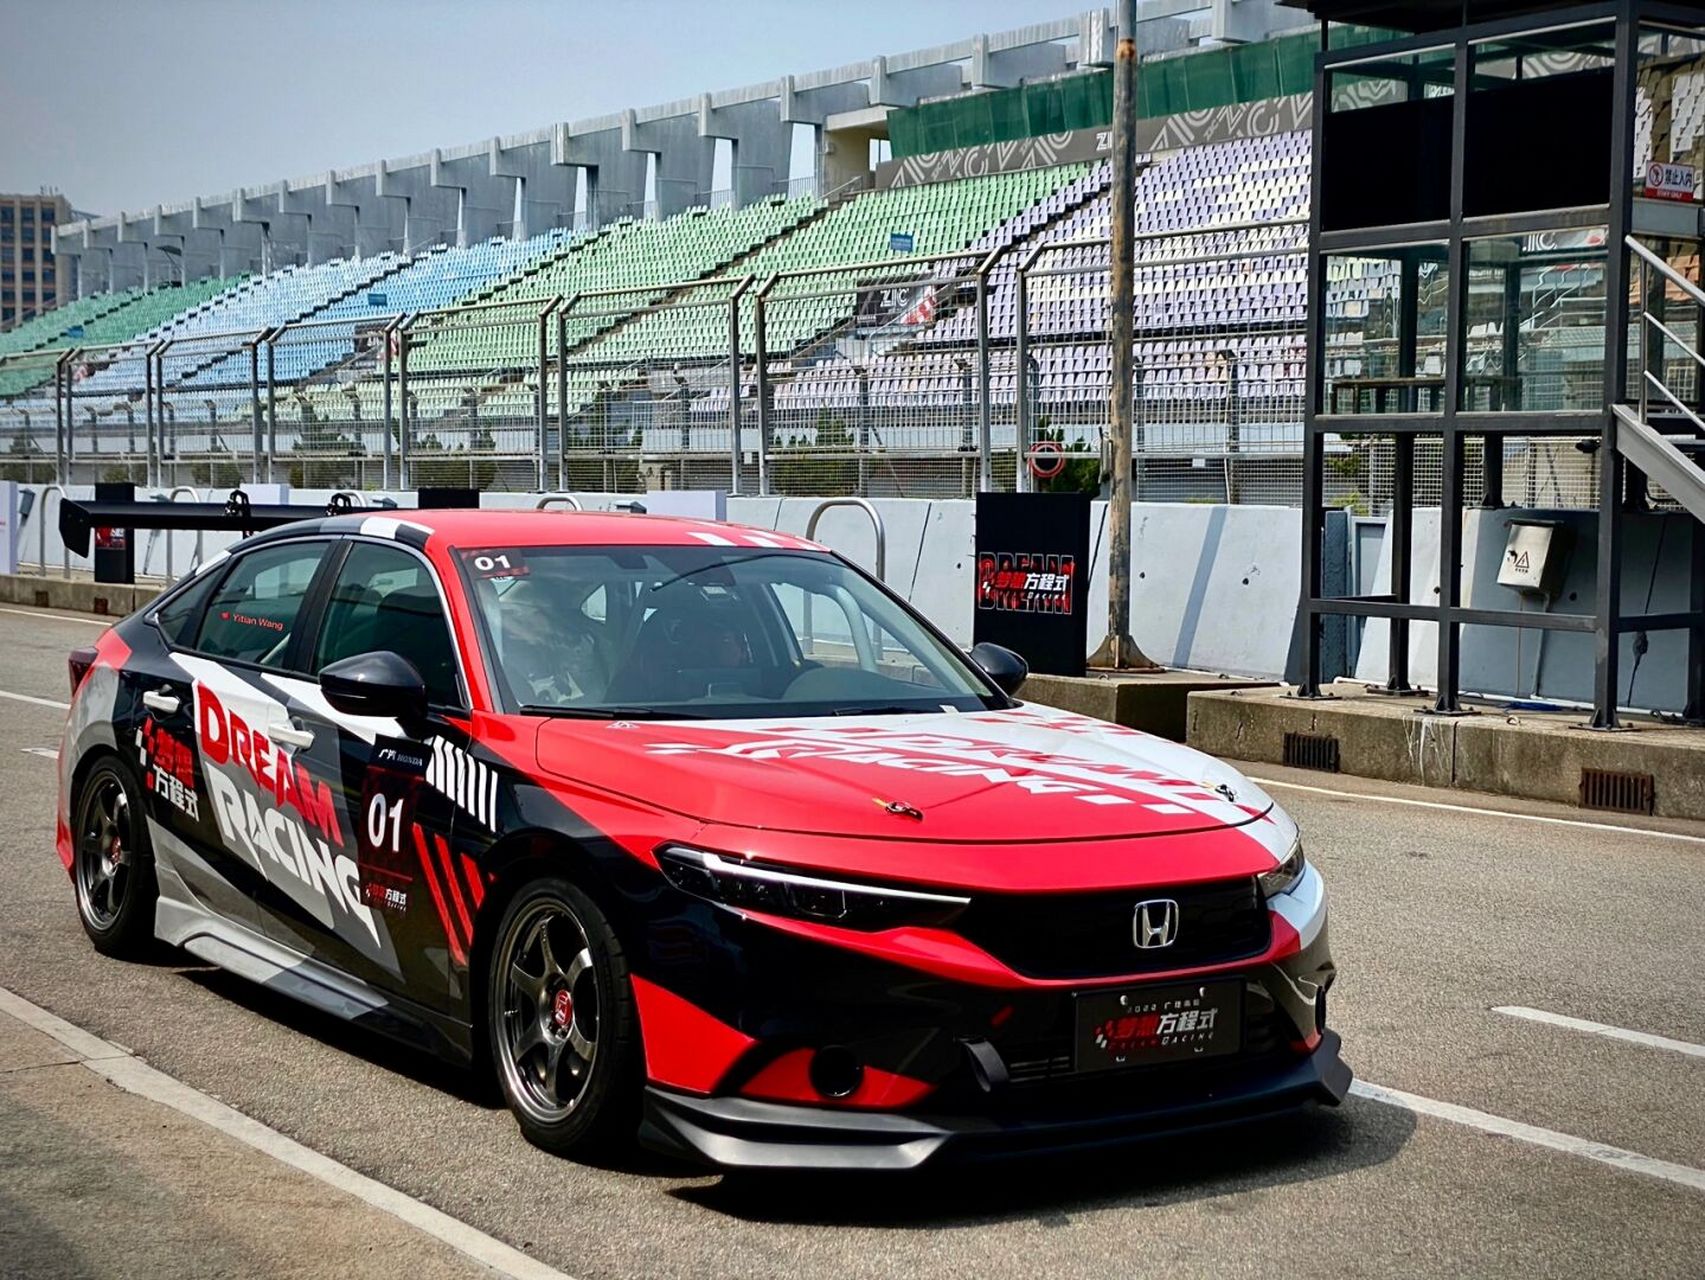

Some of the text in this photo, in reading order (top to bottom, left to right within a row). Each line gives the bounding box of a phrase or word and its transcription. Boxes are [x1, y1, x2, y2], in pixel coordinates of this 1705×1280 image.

[1096, 131, 1113, 151] ZI
[1665, 168, 1693, 188] 禁止入内
[474, 554, 511, 571] 01
[258, 617, 284, 632] Wang
[197, 680, 344, 847] DREAM
[153, 763, 199, 822] 方程式
[368, 793, 404, 852] 01
[204, 761, 381, 948] RACING
